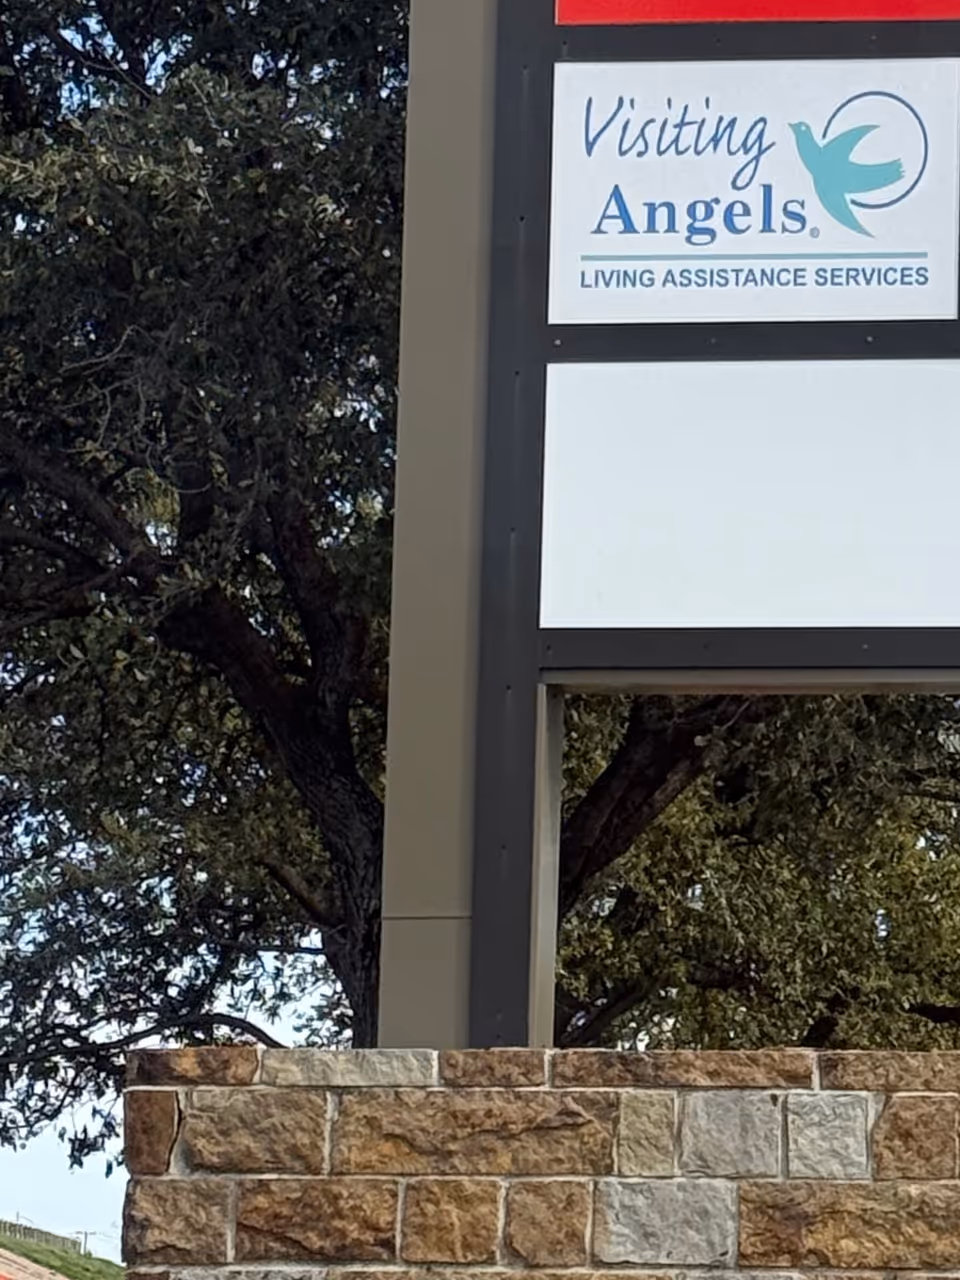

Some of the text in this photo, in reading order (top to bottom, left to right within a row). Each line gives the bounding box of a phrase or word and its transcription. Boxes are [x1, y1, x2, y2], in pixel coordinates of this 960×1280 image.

[584, 96, 776, 192] Visiting
[590, 183, 807, 246] Angels
[580, 266, 930, 289] LIVING ASSISTANCE SERVICES
